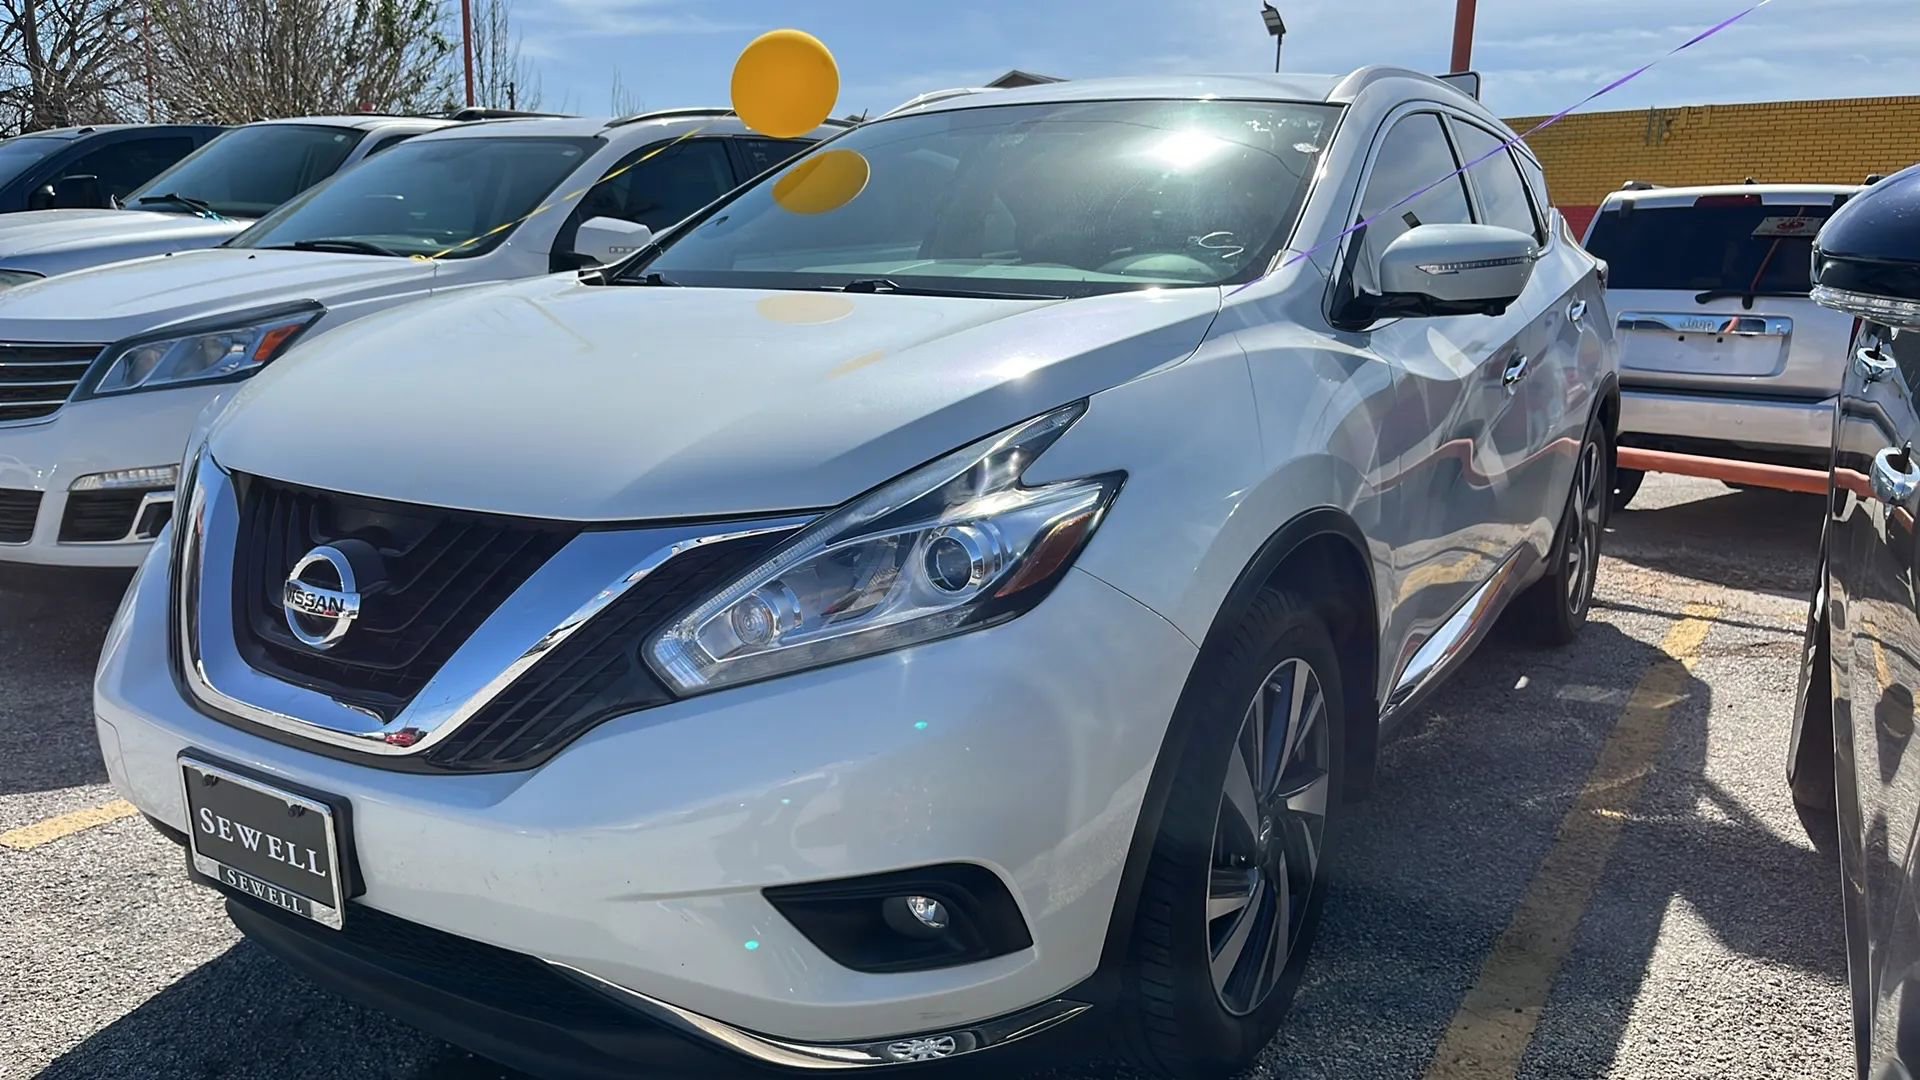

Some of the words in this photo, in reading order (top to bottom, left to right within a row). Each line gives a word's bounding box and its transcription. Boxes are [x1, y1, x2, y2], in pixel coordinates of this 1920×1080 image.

[285, 587, 346, 613] NISSAN
[200, 807, 326, 877] SEWELL
[227, 869, 303, 913] SEWELL
